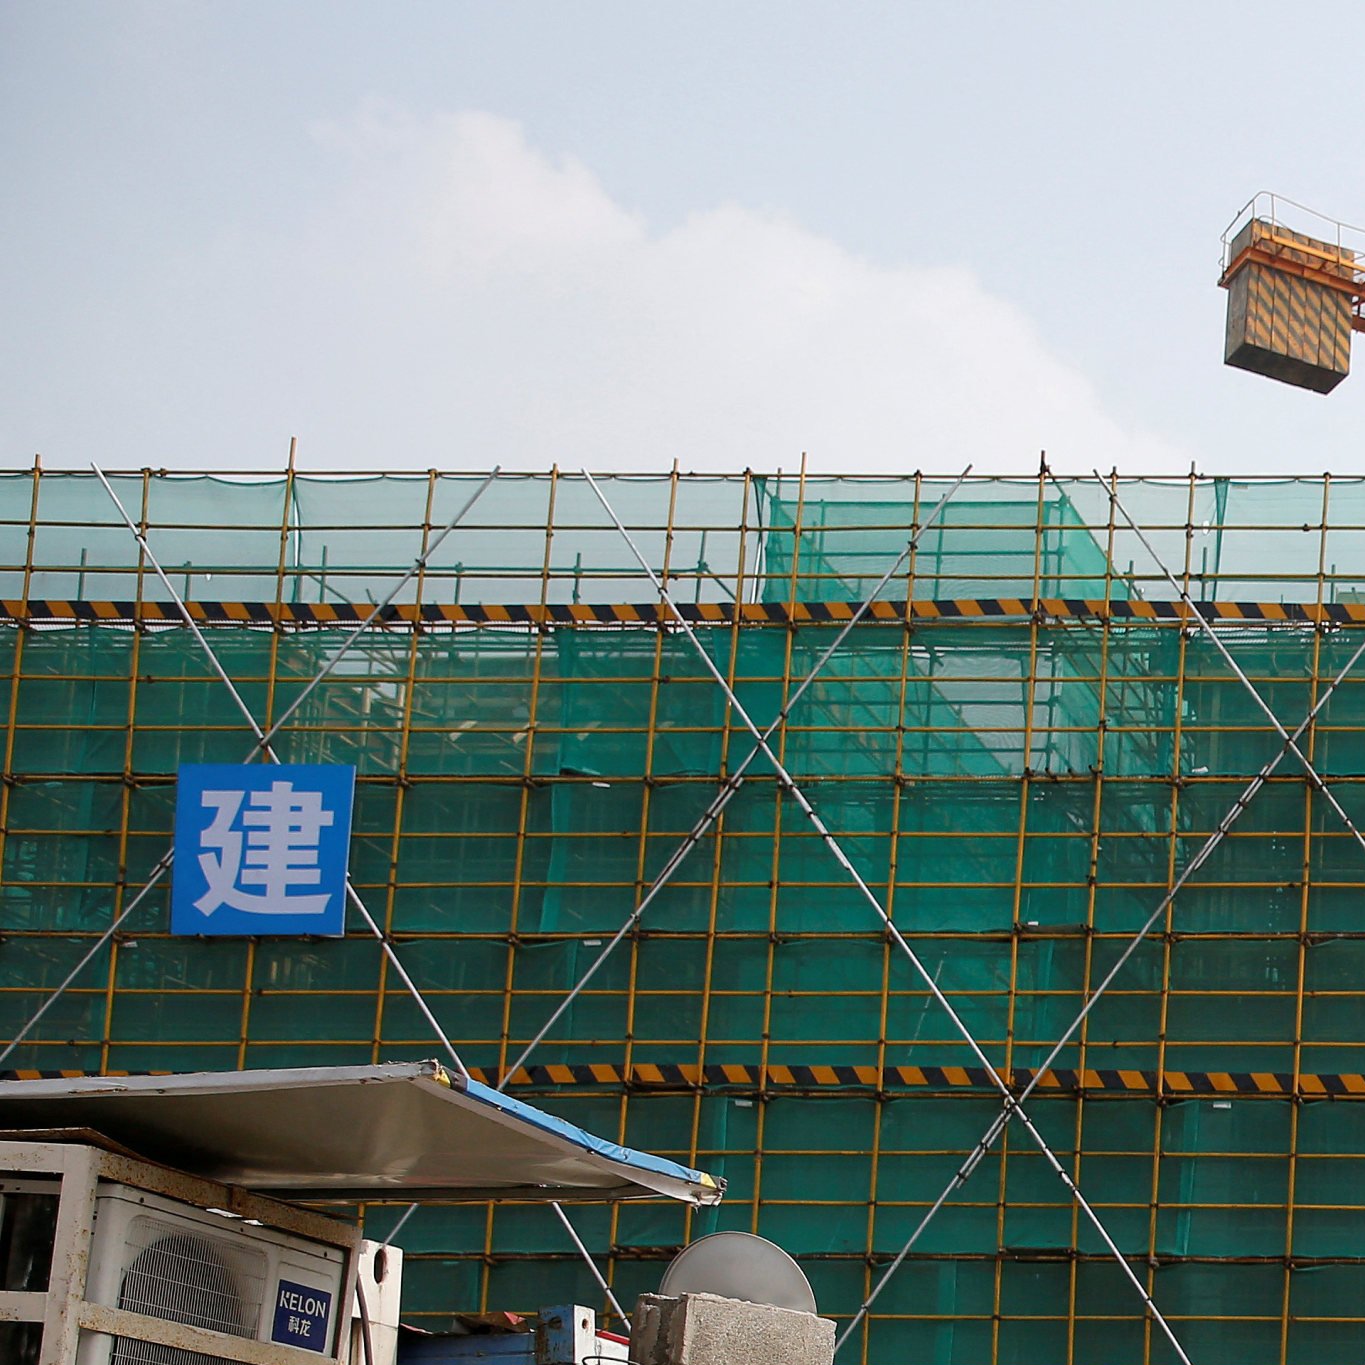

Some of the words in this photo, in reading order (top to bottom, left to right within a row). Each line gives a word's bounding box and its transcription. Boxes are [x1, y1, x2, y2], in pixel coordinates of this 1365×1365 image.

[193, 781, 334, 916] 建
[280, 1290, 326, 1318] KELON
[288, 1315, 312, 1337] 科龙
